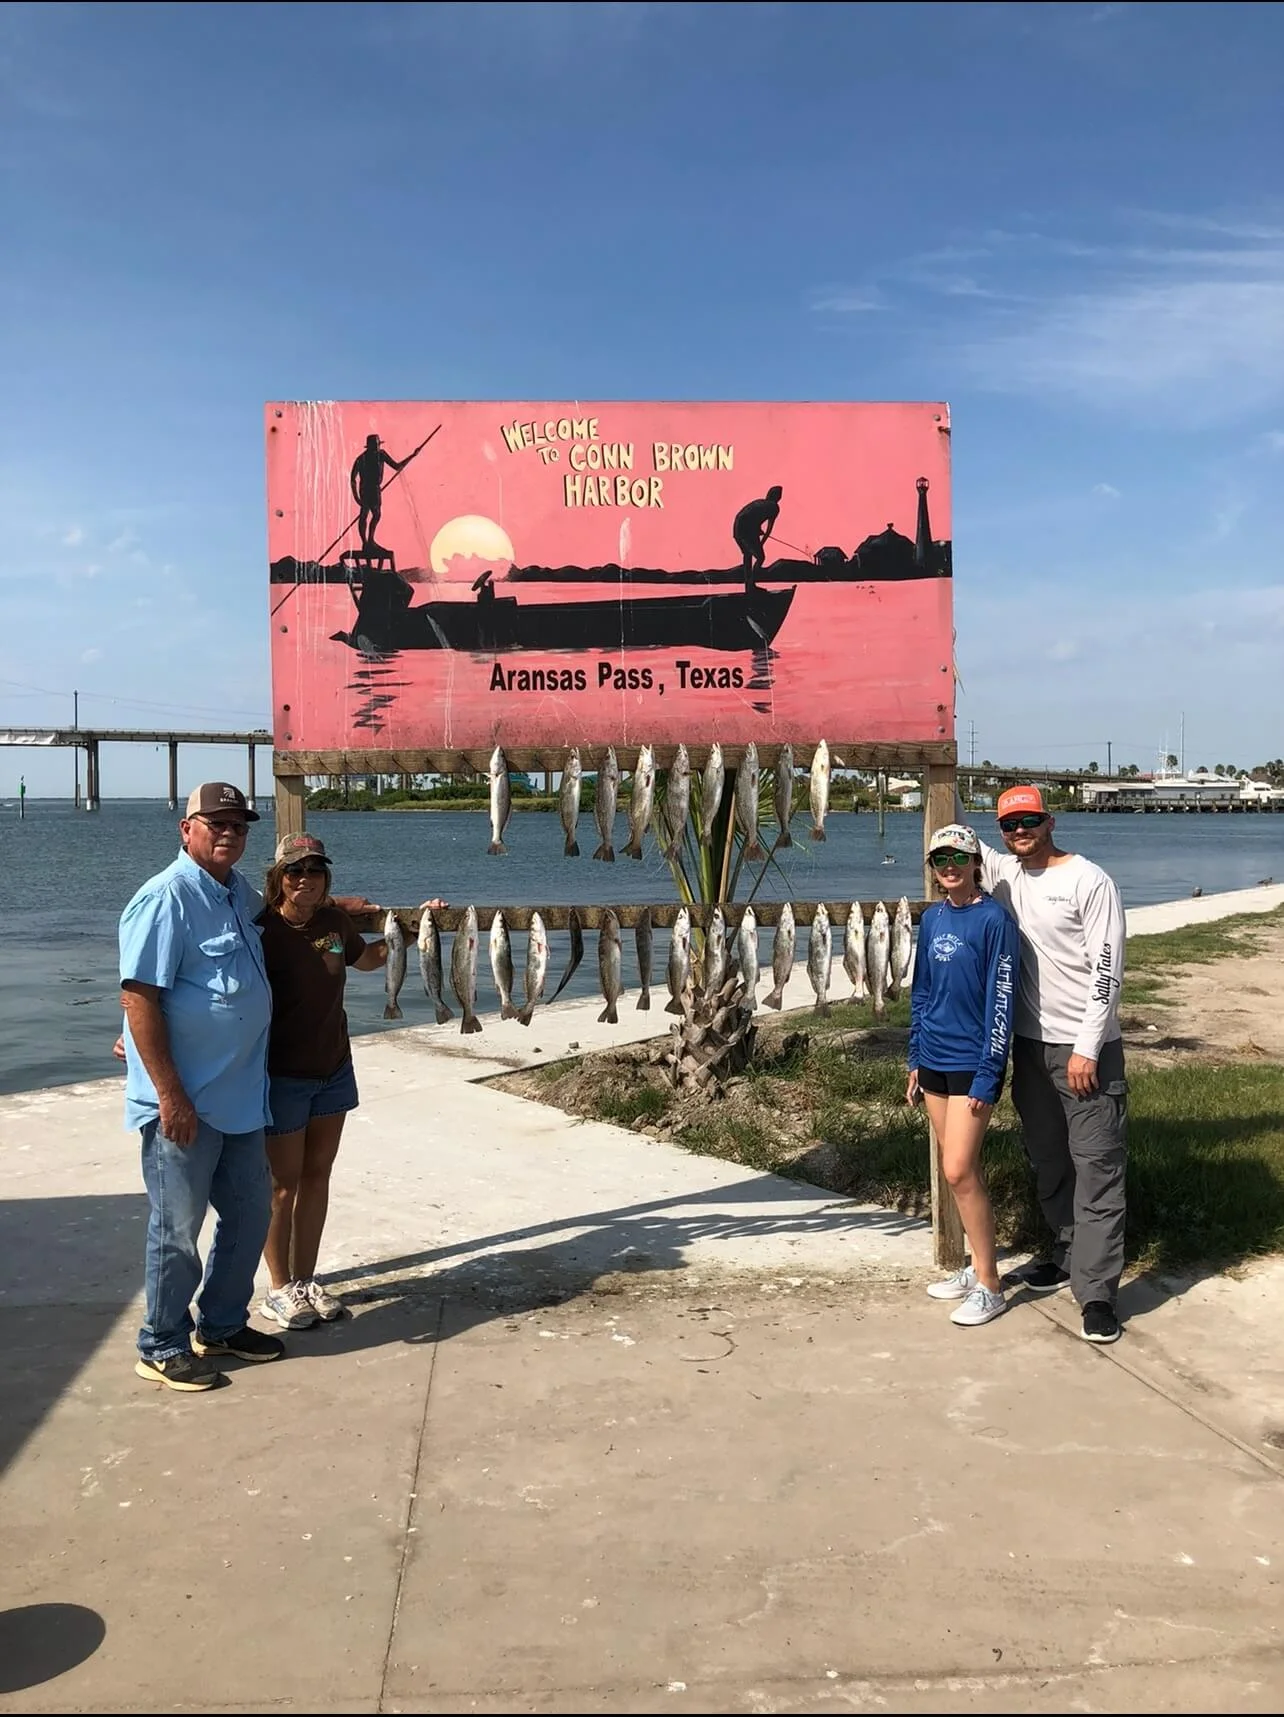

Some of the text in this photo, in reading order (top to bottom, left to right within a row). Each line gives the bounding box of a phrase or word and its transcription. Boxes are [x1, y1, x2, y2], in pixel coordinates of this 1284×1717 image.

[500, 417, 600, 453] WELCOME
[536, 441, 734, 472] TO CONN BROWN
[563, 474, 665, 509] HARBOR
[489, 662, 587, 691] Aransas
[675, 660, 744, 689] Texas
